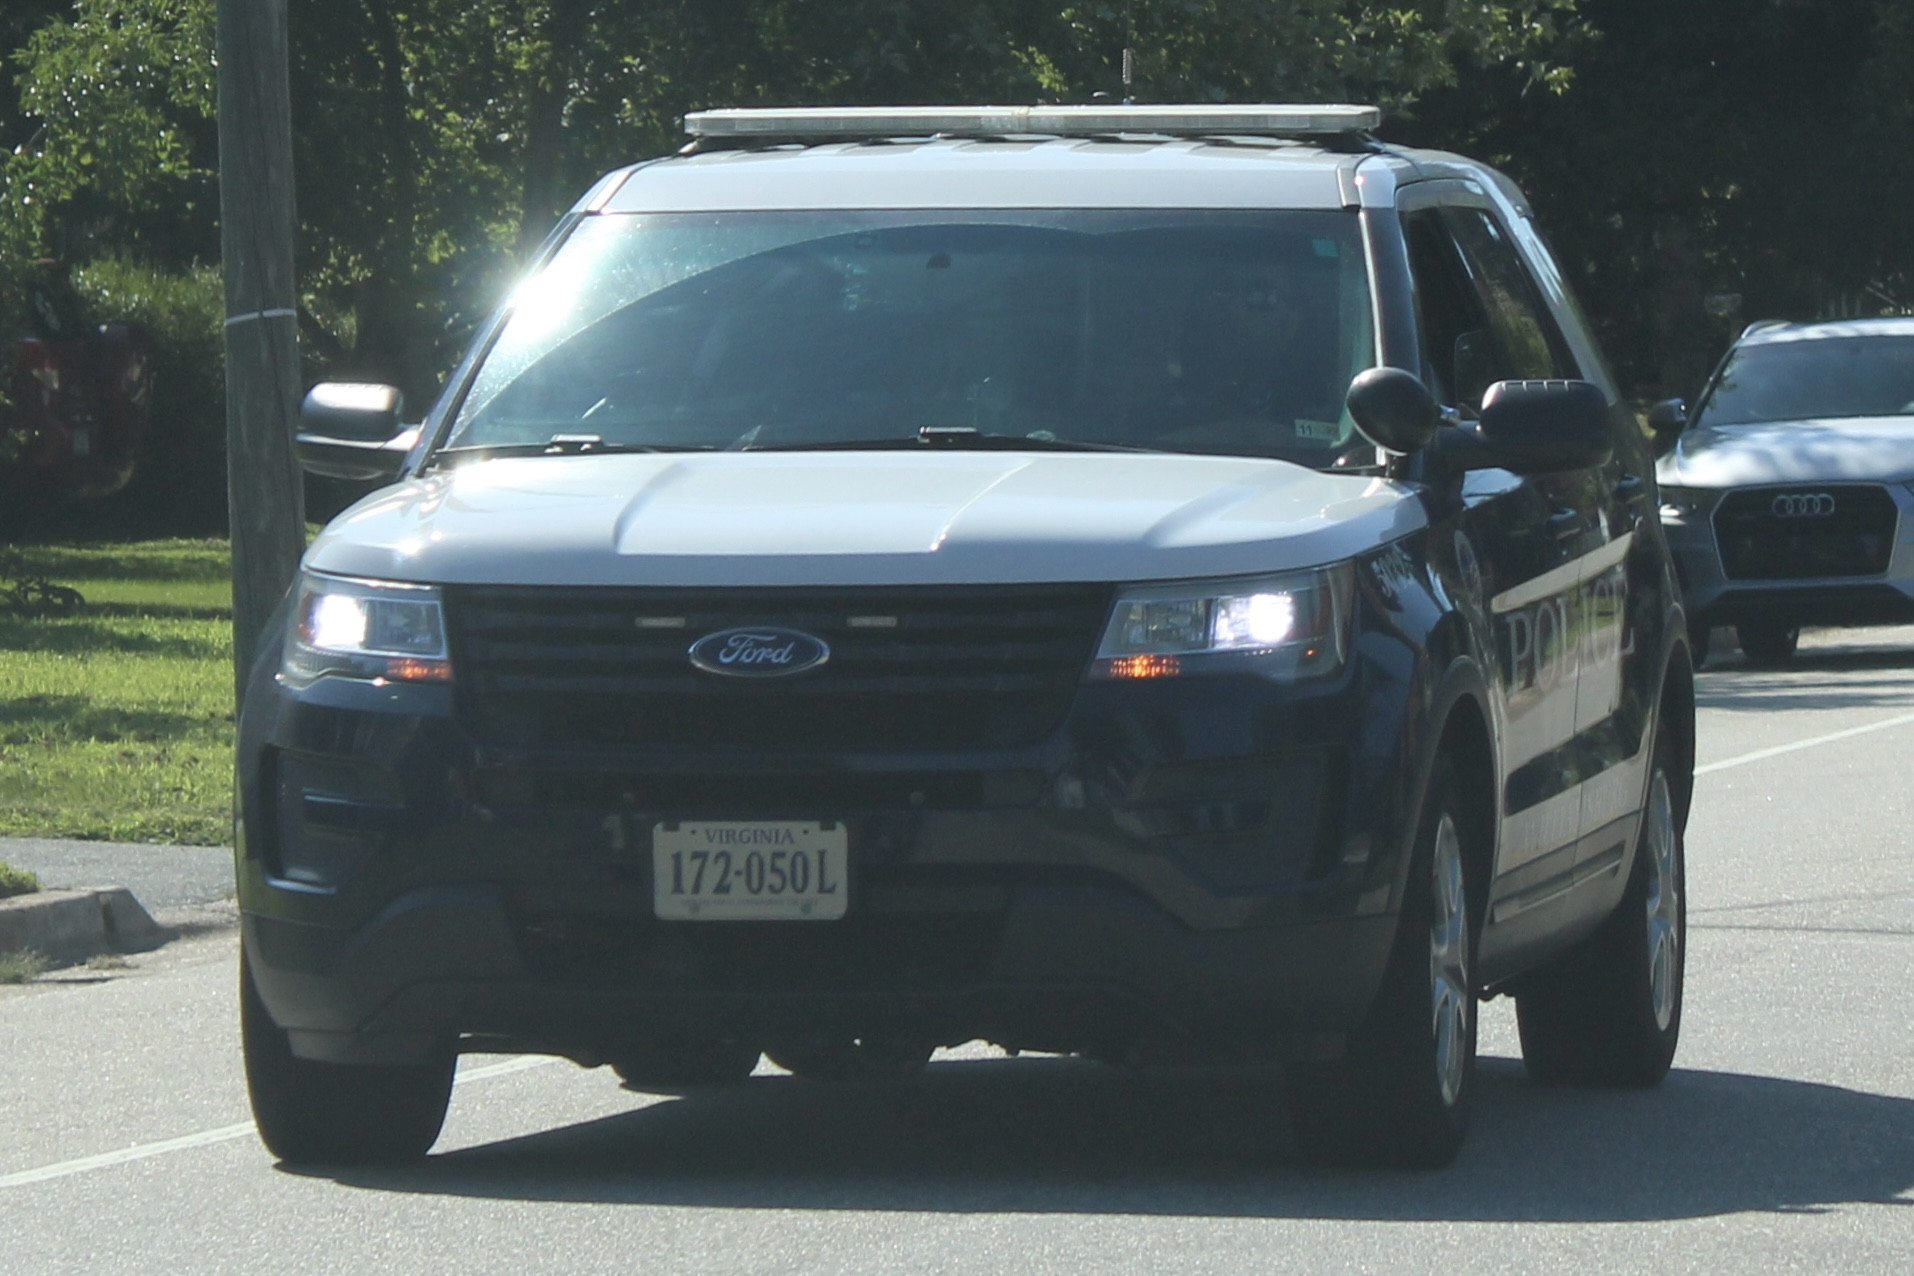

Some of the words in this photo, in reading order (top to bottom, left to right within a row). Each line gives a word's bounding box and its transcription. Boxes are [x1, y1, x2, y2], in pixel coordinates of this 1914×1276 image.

[719, 634, 795, 664] Ford
[1505, 570, 1636, 697] POLICE
[705, 828, 795, 845] VIRGINIA
[671, 849, 837, 895] 172-050L
